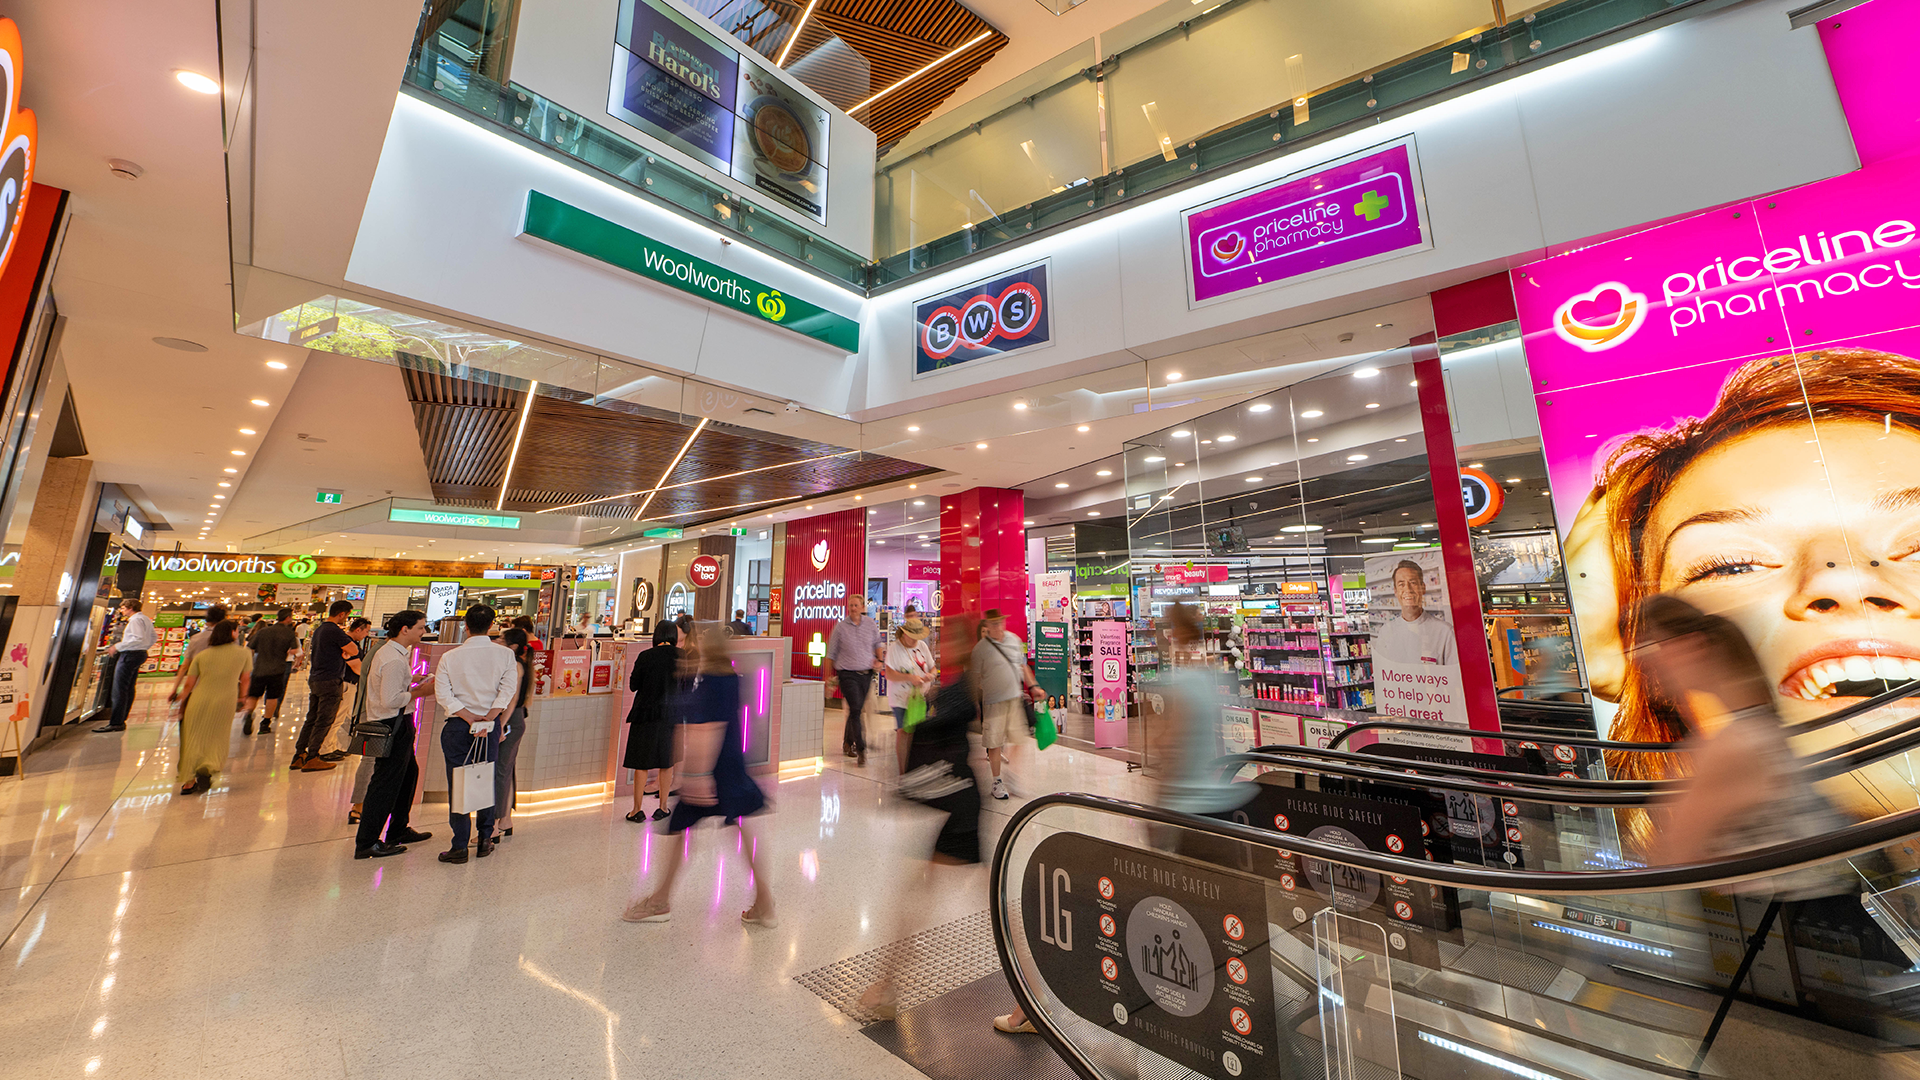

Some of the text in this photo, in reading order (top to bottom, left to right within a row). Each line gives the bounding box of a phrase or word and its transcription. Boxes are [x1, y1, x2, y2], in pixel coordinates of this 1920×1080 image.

[648, 40, 720, 99] Harol's
[665, 77, 703, 102] ESPRESSO
[645, 81, 663, 94] NOW
[663, 91, 682, 105] OPEN
[689, 106, 716, 124] SERVING
[680, 108, 695, 119] BEST
[695, 117, 719, 134] COFFEE
[1253, 203, 1340, 242] priceline
[1255, 219, 1343, 257] pharmacy
[1662, 220, 1916, 307] priceline
[644, 246, 751, 305] Woolworths
[1018, 288, 1036, 304] SPIRITS
[1667, 254, 1920, 337] pharmacy
[946, 312, 959, 324] BEER
[984, 323, 996, 339] WINE
[694, 563, 716, 572] Share
[701, 572, 714, 580] tea
[1184, 570, 1205, 578] beauty
[795, 579, 846, 605] priceline
[1154, 587, 1194, 595] REVOLUTION
[793, 602, 846, 623] pharmacy
[1100, 646, 1121, 656] SALE
[1382, 669, 1449, 688] More ways
[1383, 687, 1451, 705] to help you
[1236, 717, 1249, 725] SALE
[1384, 703, 1444, 721] feel great
[1310, 727, 1341, 738] ON SALE
[1287, 799, 1382, 825] PLEASE RIDE SAFELY
[1113, 857, 1221, 900] PLEASE RIDE SAFELY
[1039, 862, 1073, 951] LG
[1153, 906, 1175, 918] HANDRAIL
[1159, 903, 1172, 911] HOLD
[1170, 918, 1188, 928] HANDS
[1134, 1017, 1215, 1061] OR USE LIFTS PROVIDED
